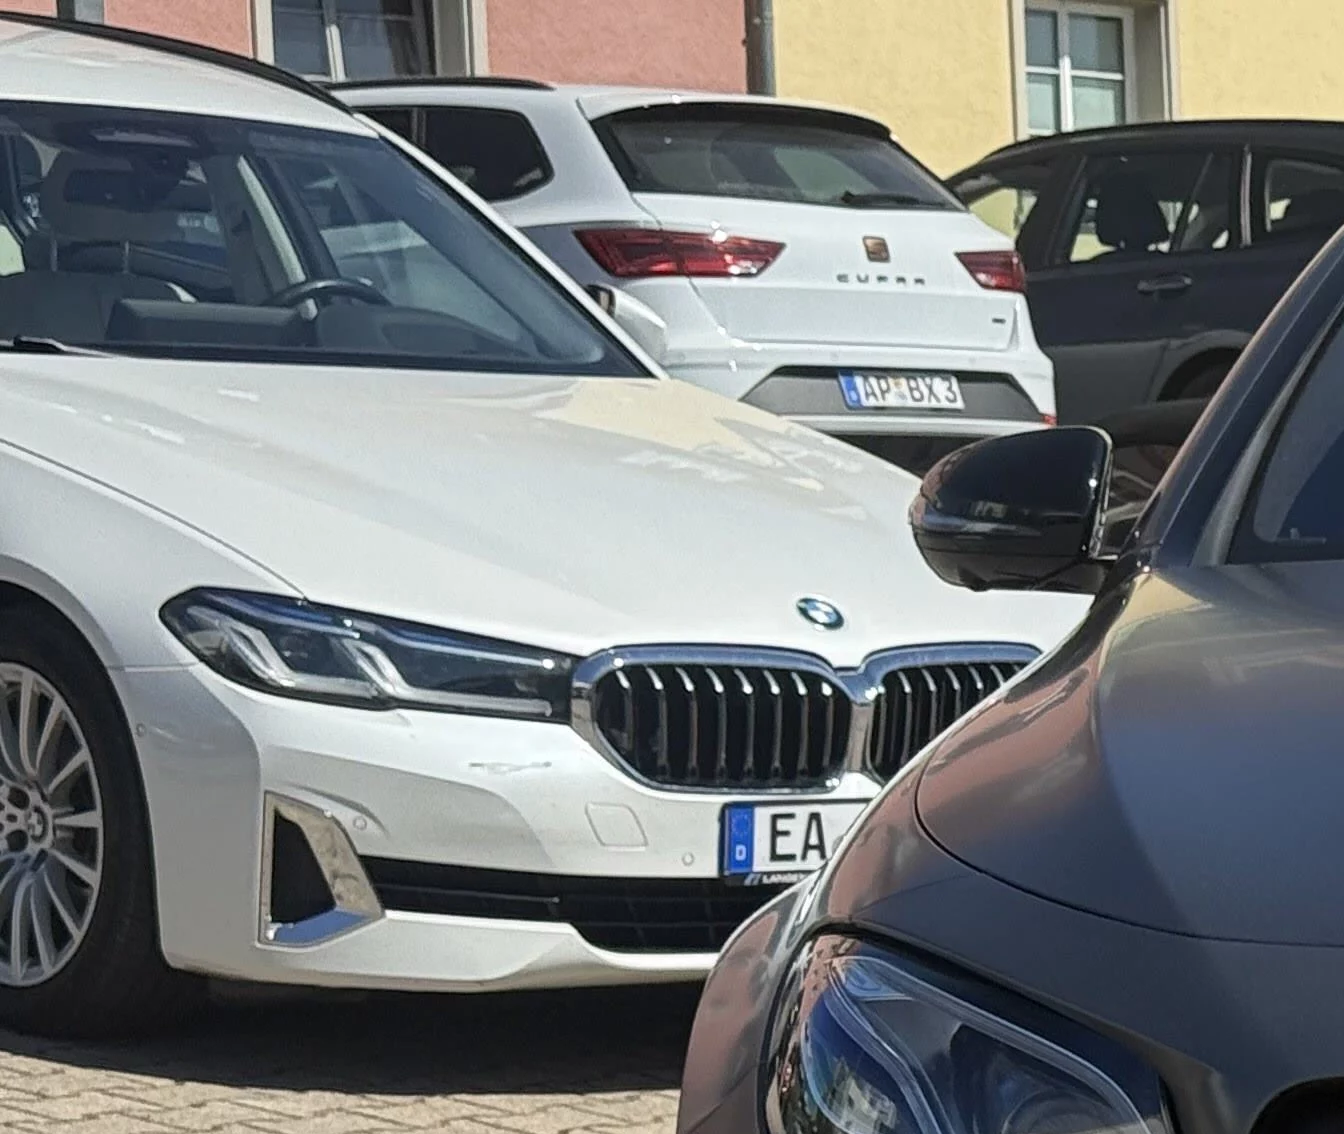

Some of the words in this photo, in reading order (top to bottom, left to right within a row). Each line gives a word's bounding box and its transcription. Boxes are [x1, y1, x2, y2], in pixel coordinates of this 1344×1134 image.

[862, 375, 890, 402] AP
[906, 376, 941, 403] BX
[944, 376, 958, 403] 3
[736, 845, 747, 861] D
[770, 812, 827, 861] EA
